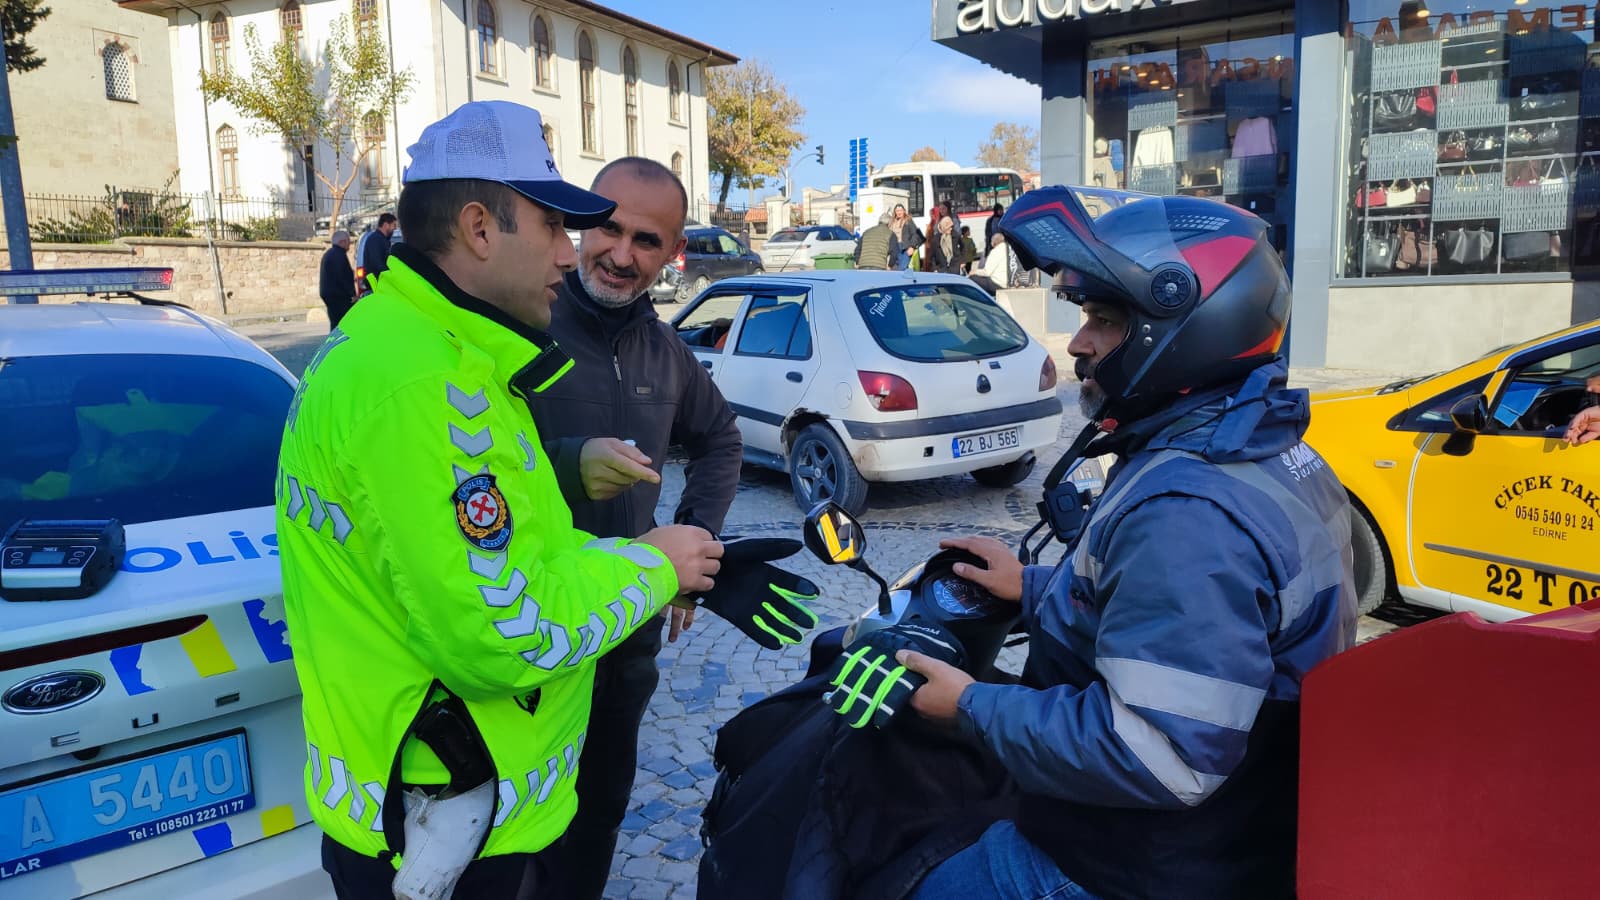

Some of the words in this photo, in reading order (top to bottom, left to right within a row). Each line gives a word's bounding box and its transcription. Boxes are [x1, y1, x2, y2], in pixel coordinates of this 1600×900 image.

[960, 439, 973, 454] 22
[979, 435, 993, 450] BJ
[998, 431, 1017, 446] 565
[1515, 505, 1539, 522] 0545
[1543, 509, 1561, 525] 540
[1565, 513, 1577, 528] 91
[1581, 515, 1594, 531] 24
[1486, 564, 1523, 600] 22
[1534, 569, 1557, 607] T
[21, 794, 55, 850] A
[90, 746, 234, 827] 5440
[196, 807, 217, 823] 222
[219, 804, 229, 817] 11
[232, 799, 245, 812] 77
